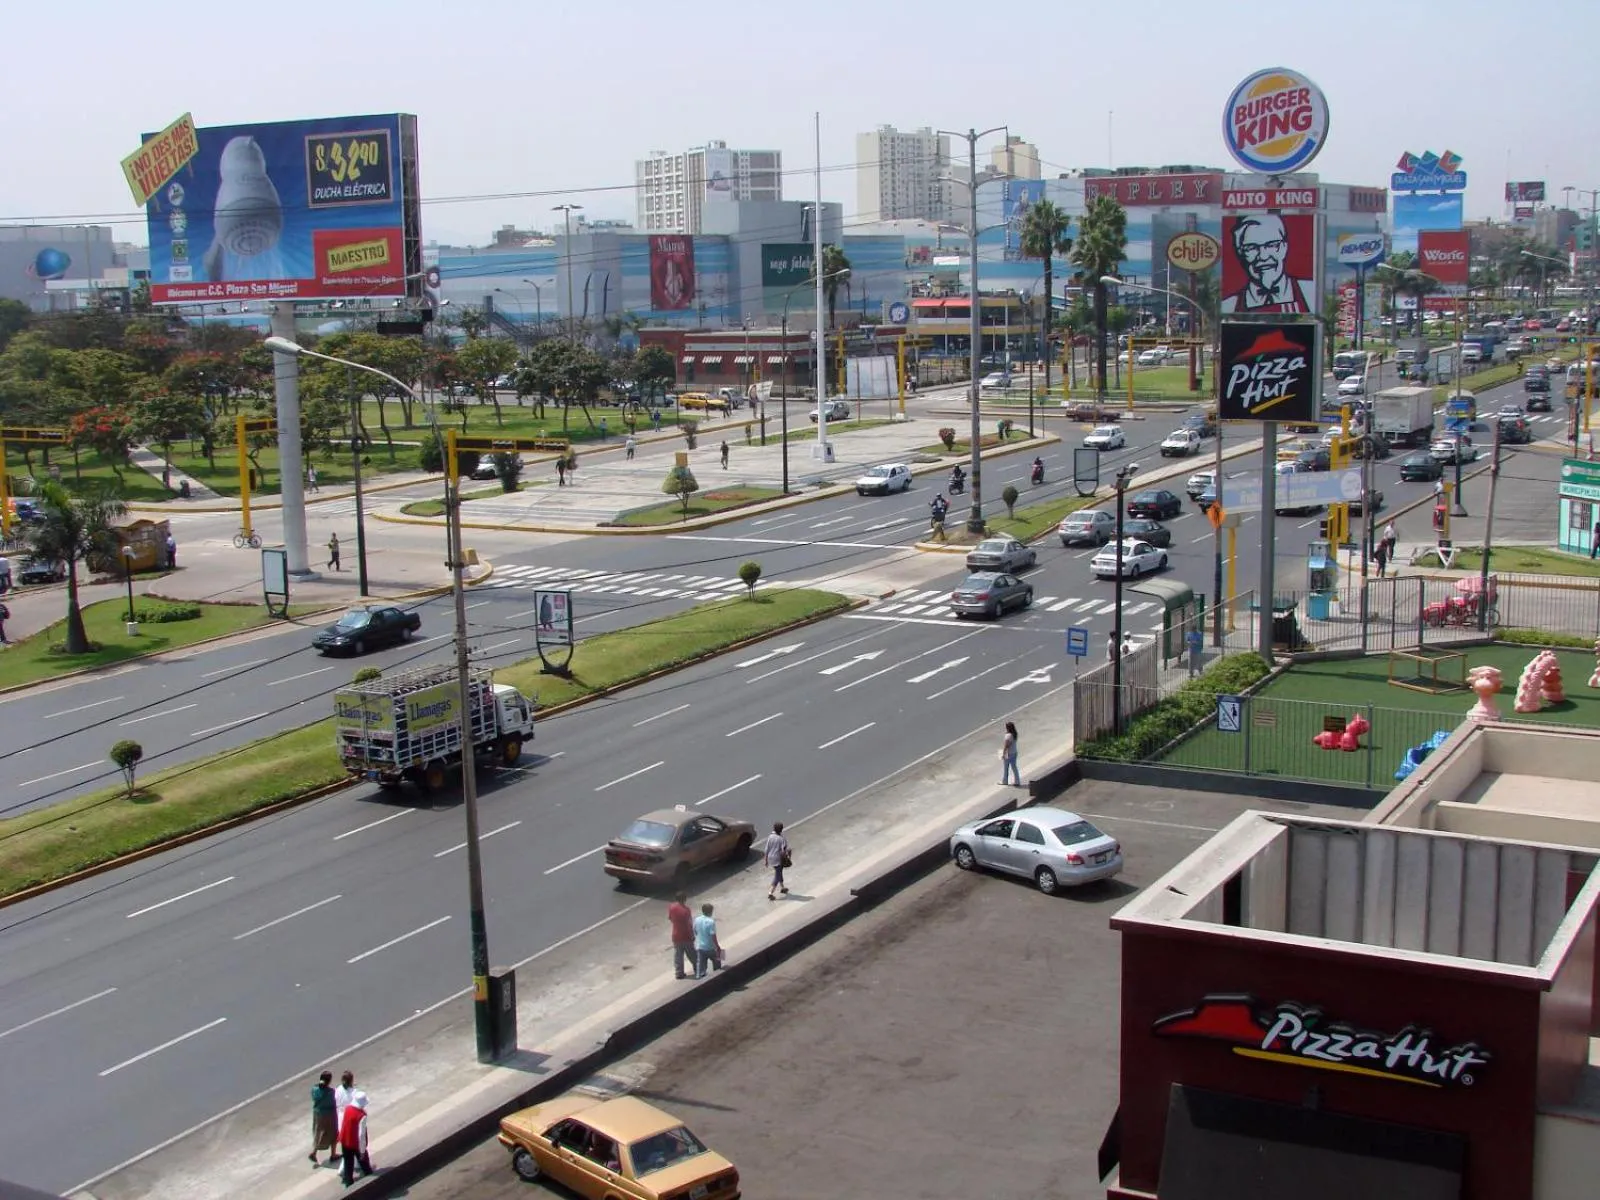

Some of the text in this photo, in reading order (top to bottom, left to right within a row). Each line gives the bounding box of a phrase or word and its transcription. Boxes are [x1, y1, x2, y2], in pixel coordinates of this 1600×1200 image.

[1235, 87, 1310, 125] BURGER
[1236, 105, 1312, 150] KING
[152, 135, 171, 161] DES
[139, 133, 195, 196] VUELTAS!
[315, 182, 386, 199] DUCHA ELÉCTRICA
[1087, 180, 1208, 201] RIPLEY
[1226, 191, 1313, 206] AUTO KING
[331, 244, 385, 266] MAESTRO
[1172, 239, 1214, 263] chili's
[226, 283, 248, 295] Plaza
[250, 282, 267, 294] San
[1226, 354, 1307, 399] Pizza
[1240, 375, 1298, 408] Hut
[1262, 1012, 1486, 1079] Pizza Hut
